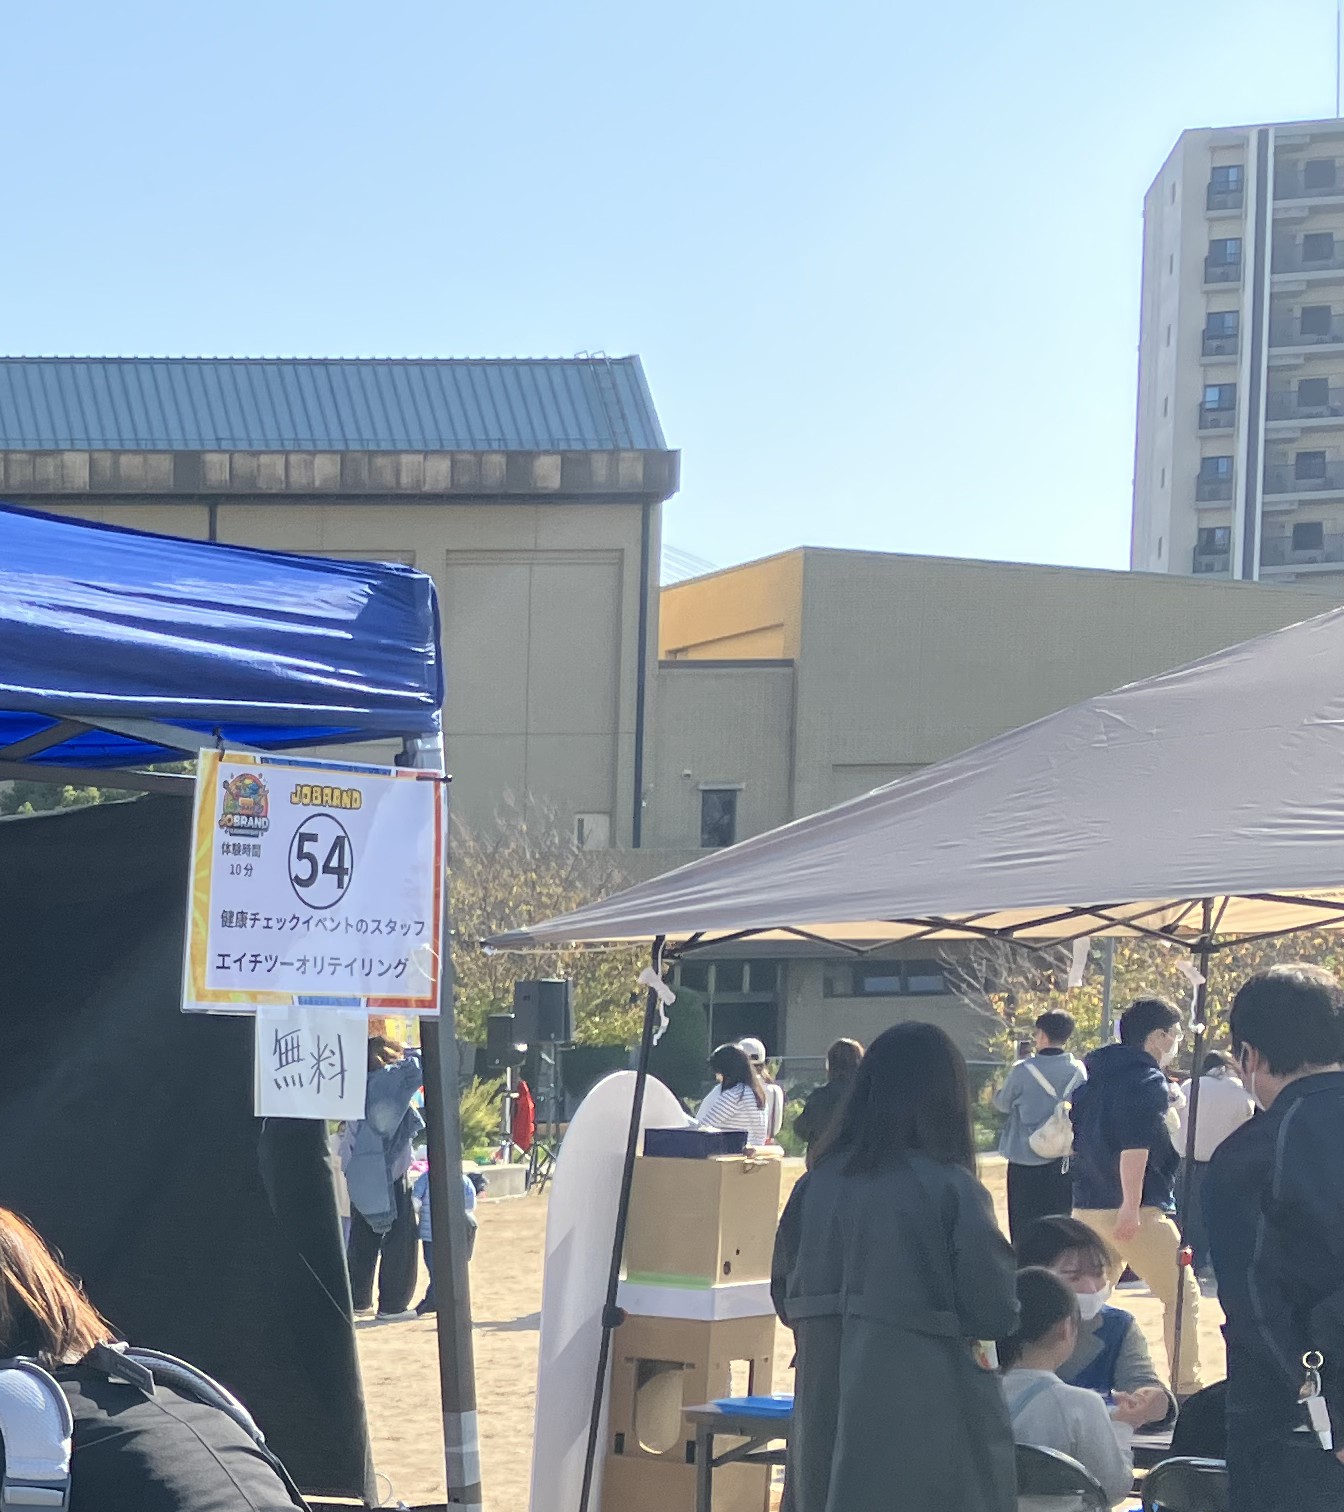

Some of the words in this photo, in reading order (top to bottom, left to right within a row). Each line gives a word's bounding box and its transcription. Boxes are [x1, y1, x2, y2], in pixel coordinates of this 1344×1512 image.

[218, 813, 270, 832] JOBRAND
[221, 842, 261, 858] 体験時間
[292, 832, 349, 889] 54
[220, 909, 426, 937] 健康チェックイベントのスタッフ
[216, 952, 410, 979] エイチツーオリテイリング
[273, 1028, 348, 1099] 無料
